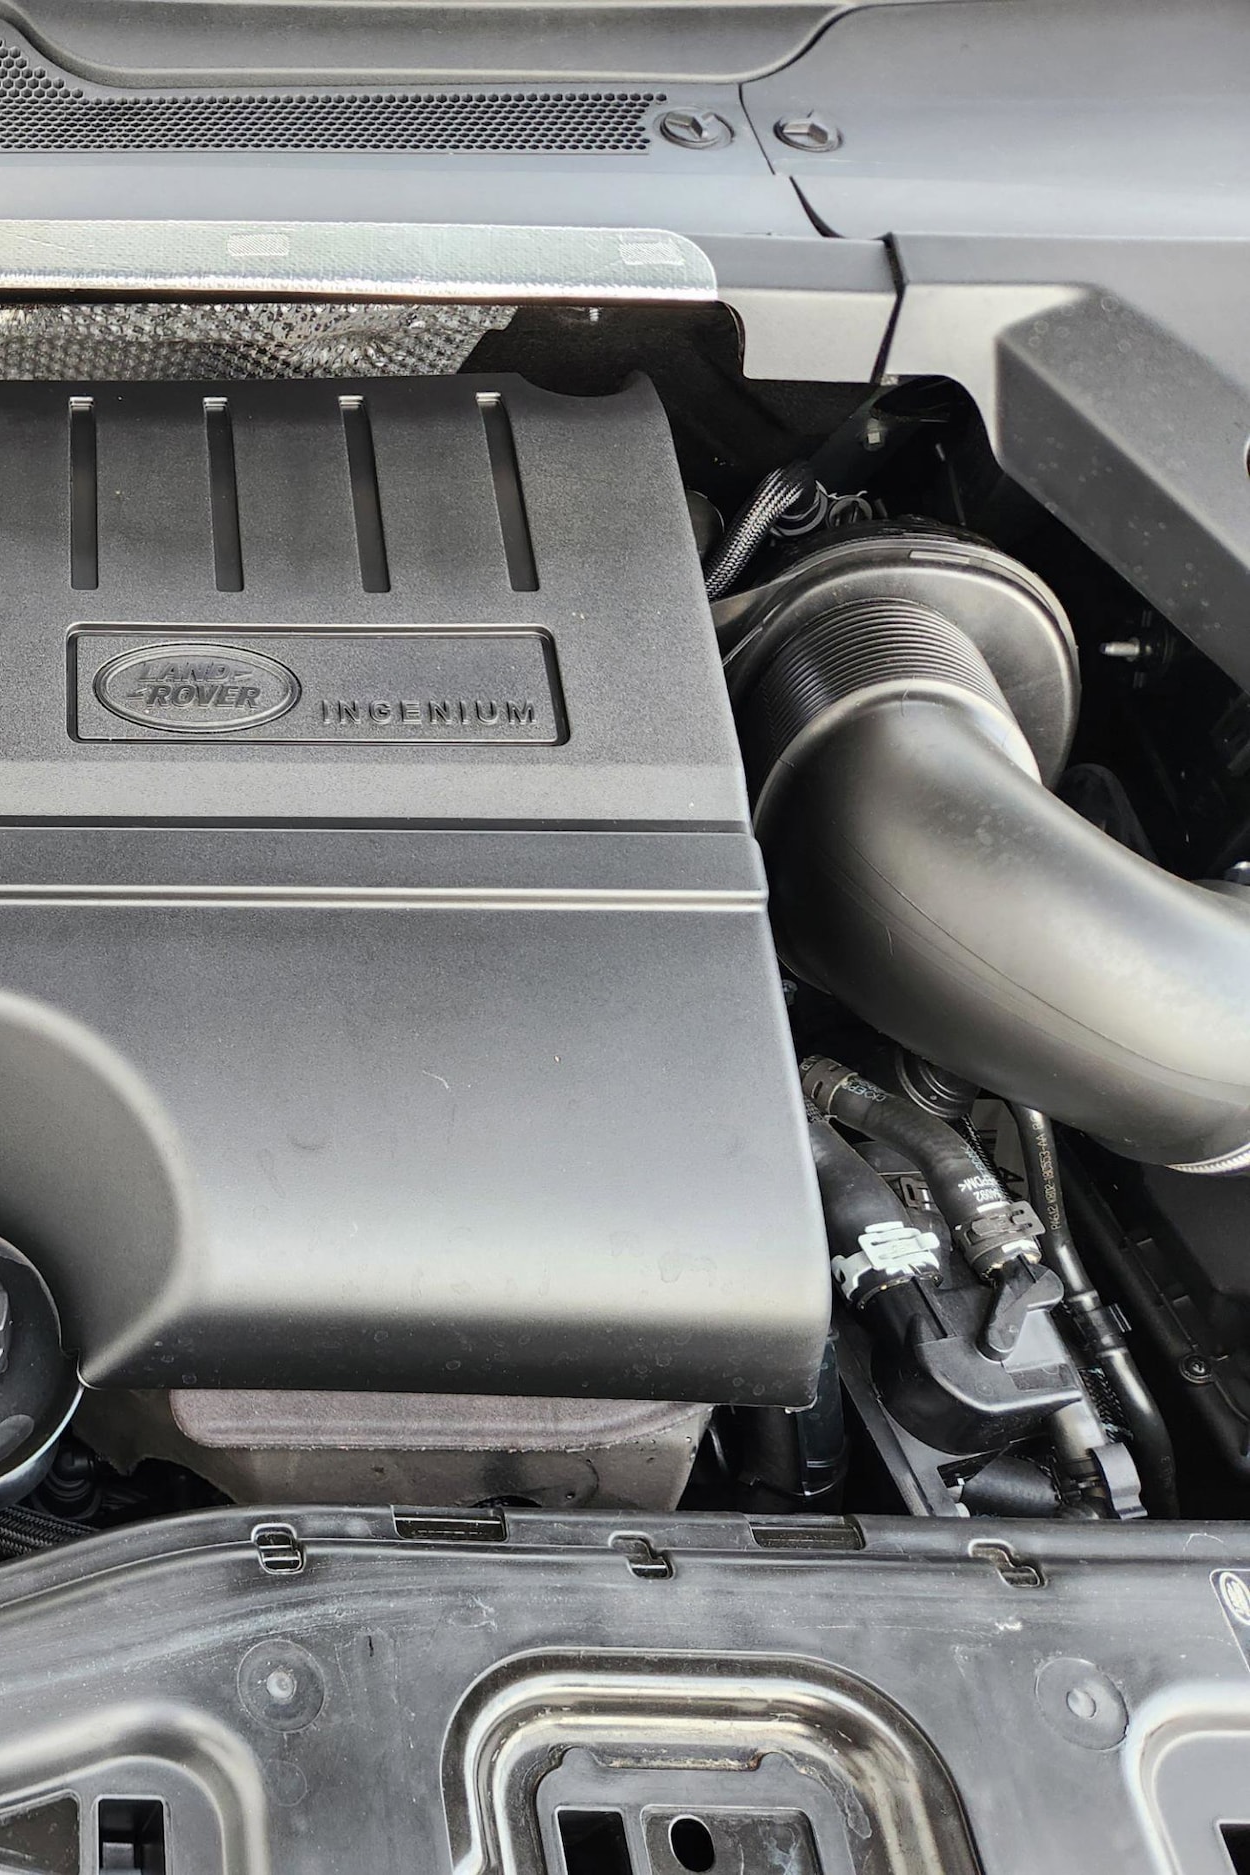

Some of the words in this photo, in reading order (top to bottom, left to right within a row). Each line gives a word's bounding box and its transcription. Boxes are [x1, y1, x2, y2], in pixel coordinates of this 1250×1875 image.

[138, 662, 231, 682] LAND
[145, 684, 261, 709] ROVER
[320, 699, 537, 725] INGENIUM
